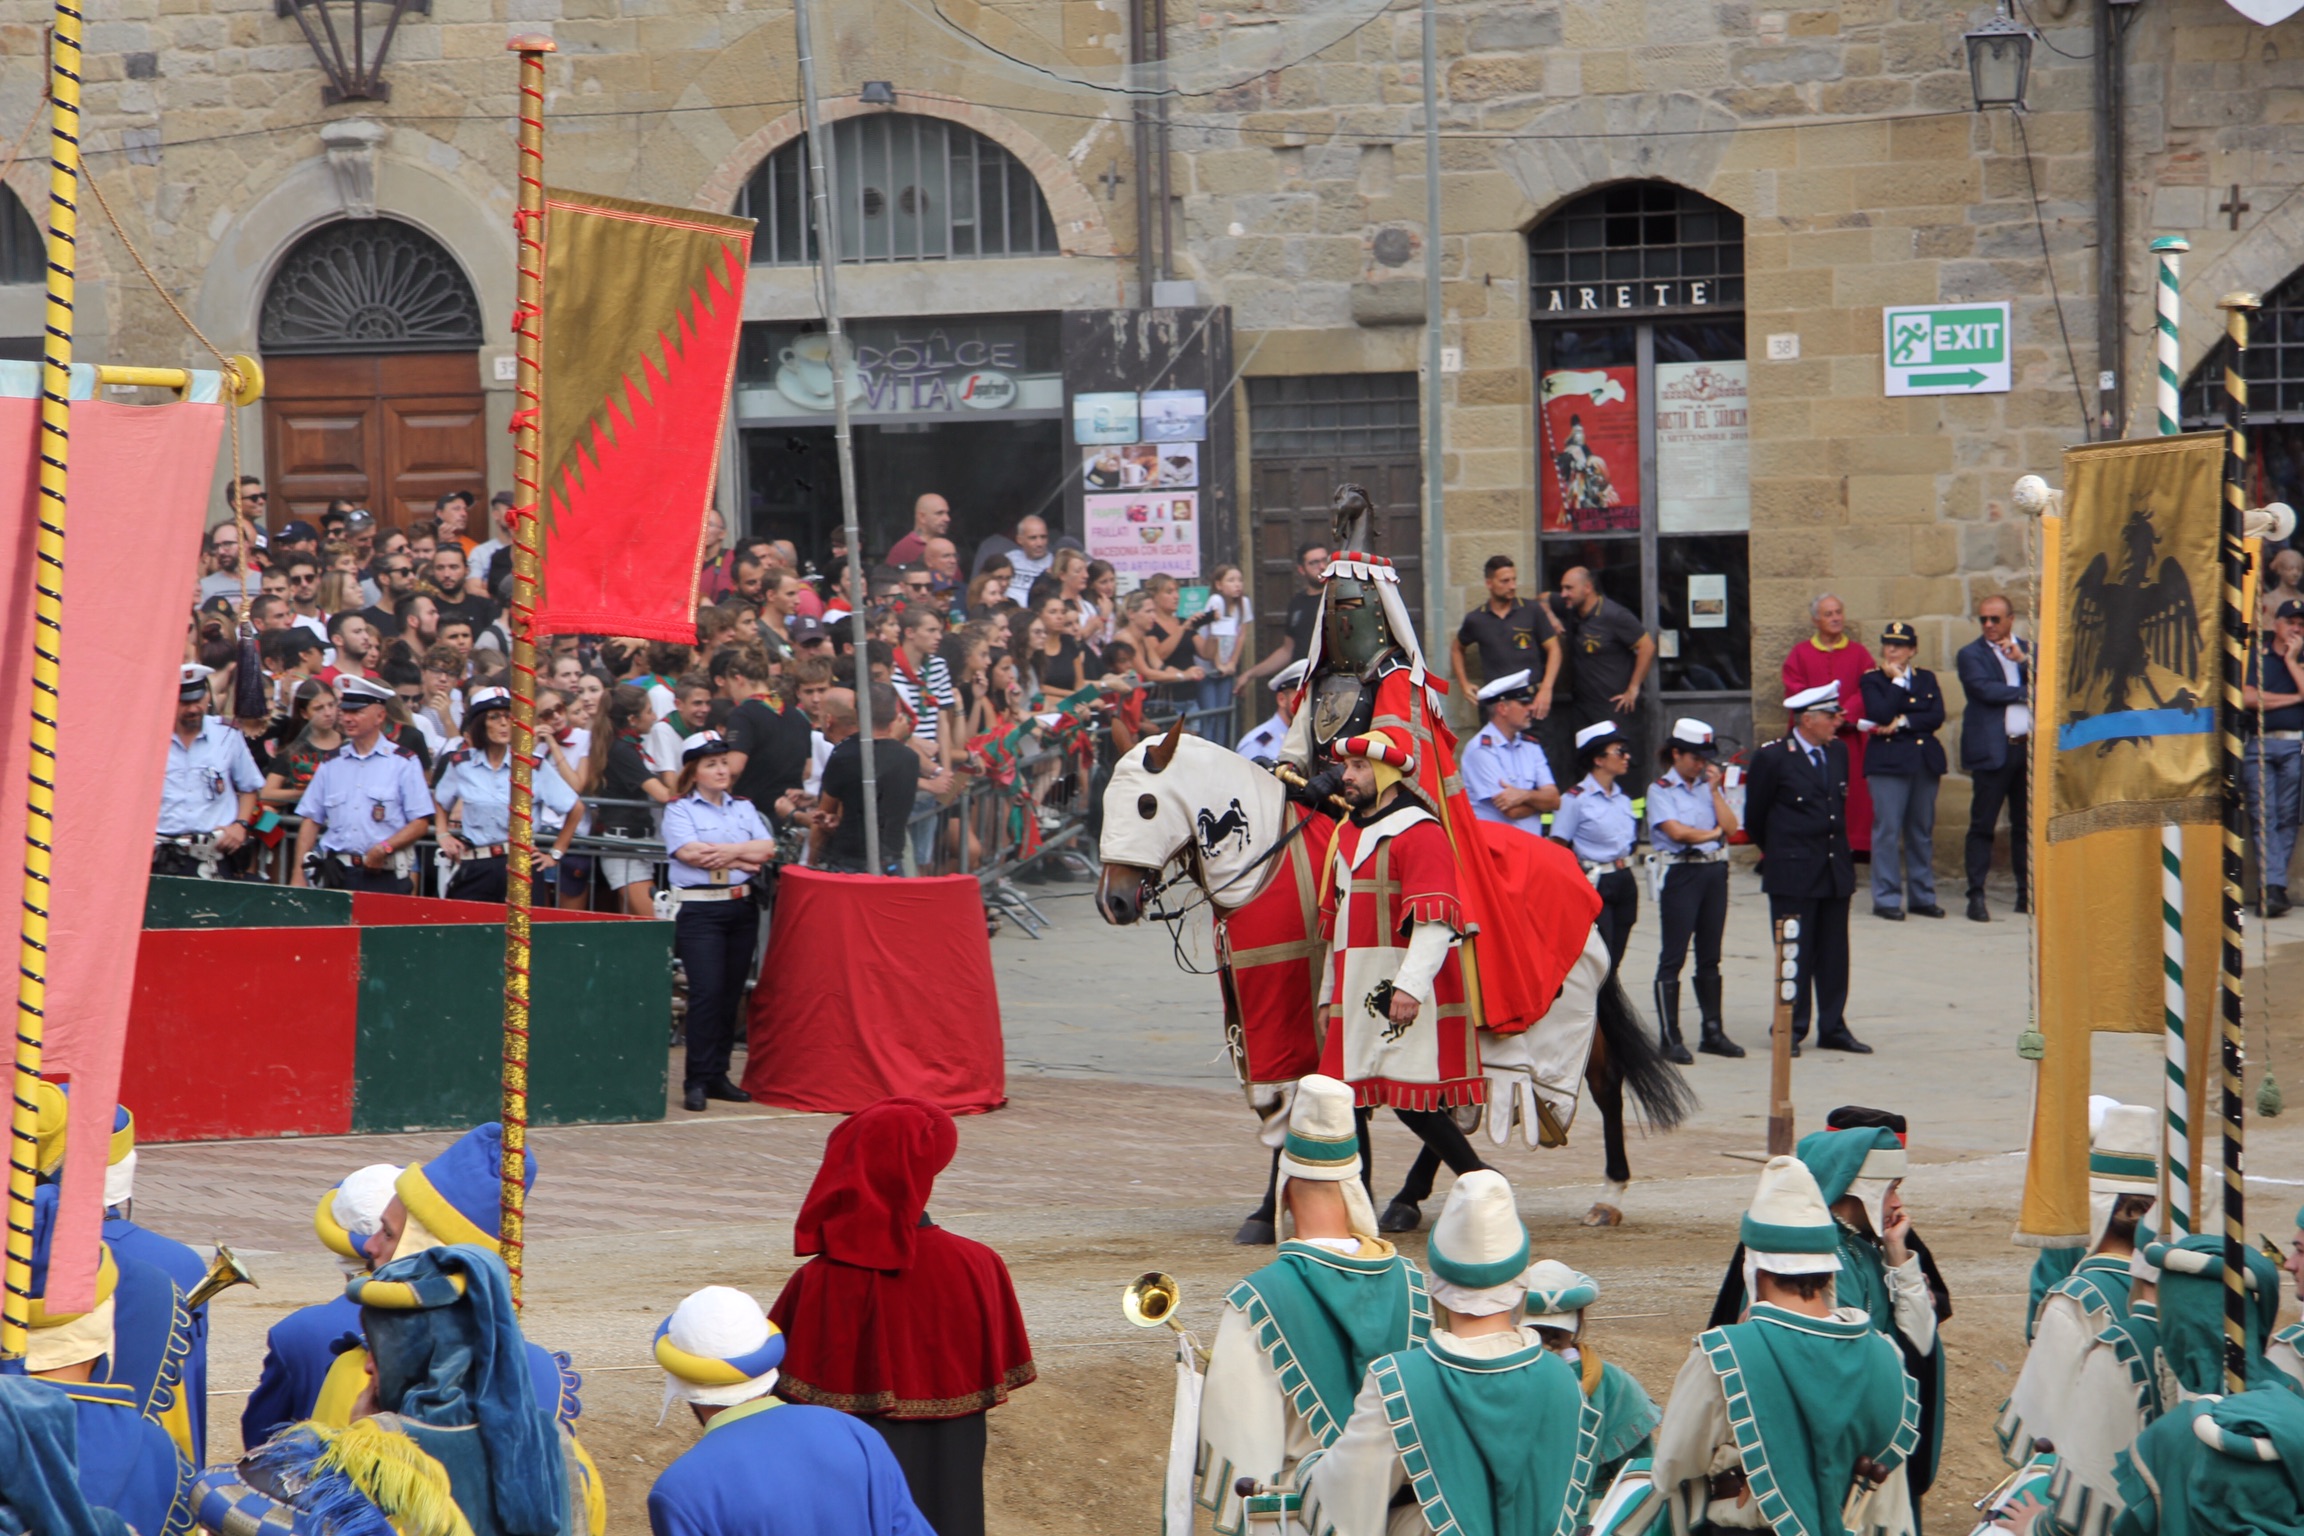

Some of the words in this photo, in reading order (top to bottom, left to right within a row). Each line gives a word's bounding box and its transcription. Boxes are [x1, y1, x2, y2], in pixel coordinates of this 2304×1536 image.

[895, 328, 950, 352] LA
[1934, 323, 2000, 351] EXIT
[857, 340, 1018, 371] DOLCE
[1773, 340, 1792, 355] 38
[857, 370, 954, 411] VITA
[1091, 526, 1129, 538] FRULLATI
[1091, 546, 1139, 557] MACEDONIA
[1141, 545, 1158, 556] CON
[1161, 544, 1192, 555] GELATO
[1131, 560, 1191, 571] ARTIGIANALE
